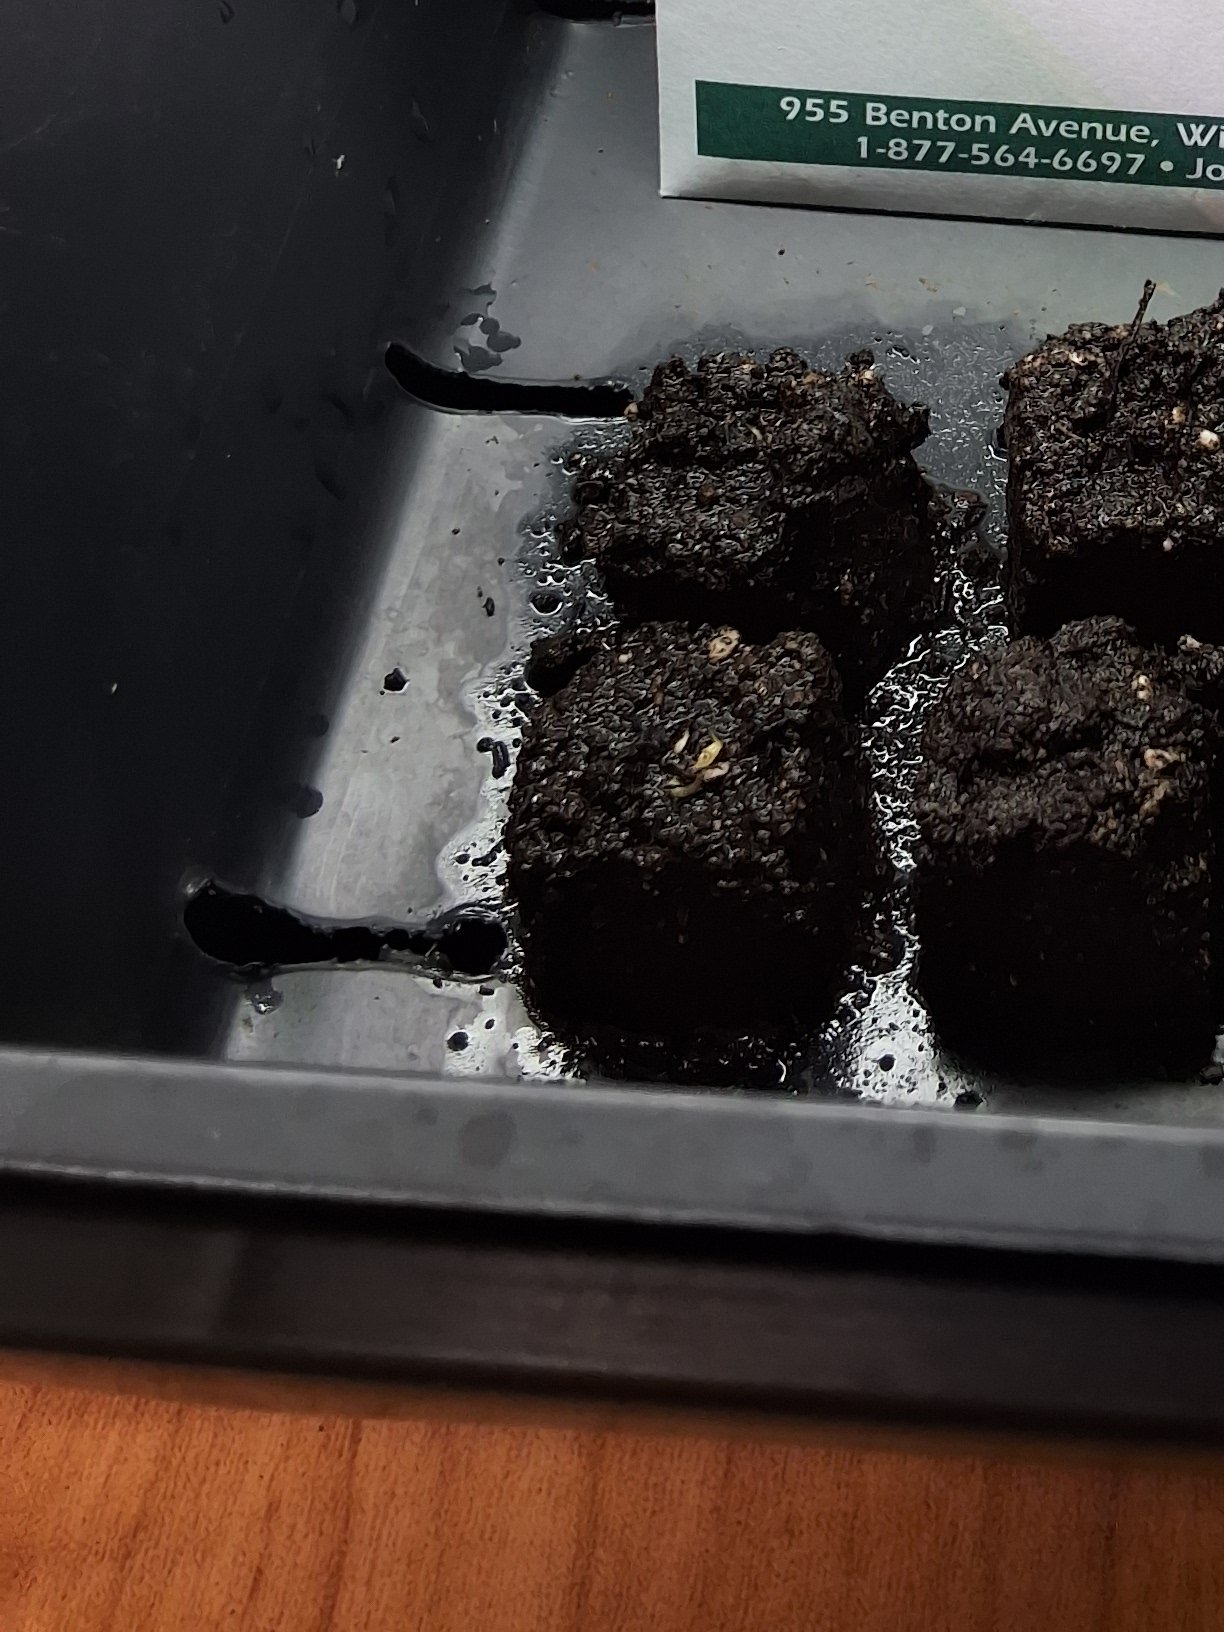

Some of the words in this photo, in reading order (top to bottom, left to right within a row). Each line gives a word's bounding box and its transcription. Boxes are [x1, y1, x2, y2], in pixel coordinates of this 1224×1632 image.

[780, 97, 848, 122] 955
[866, 103, 995, 132] Benton
[1009, 113, 1159, 147] Avenue,
[858, 136, 1146, 175] 1-877-564-6697
